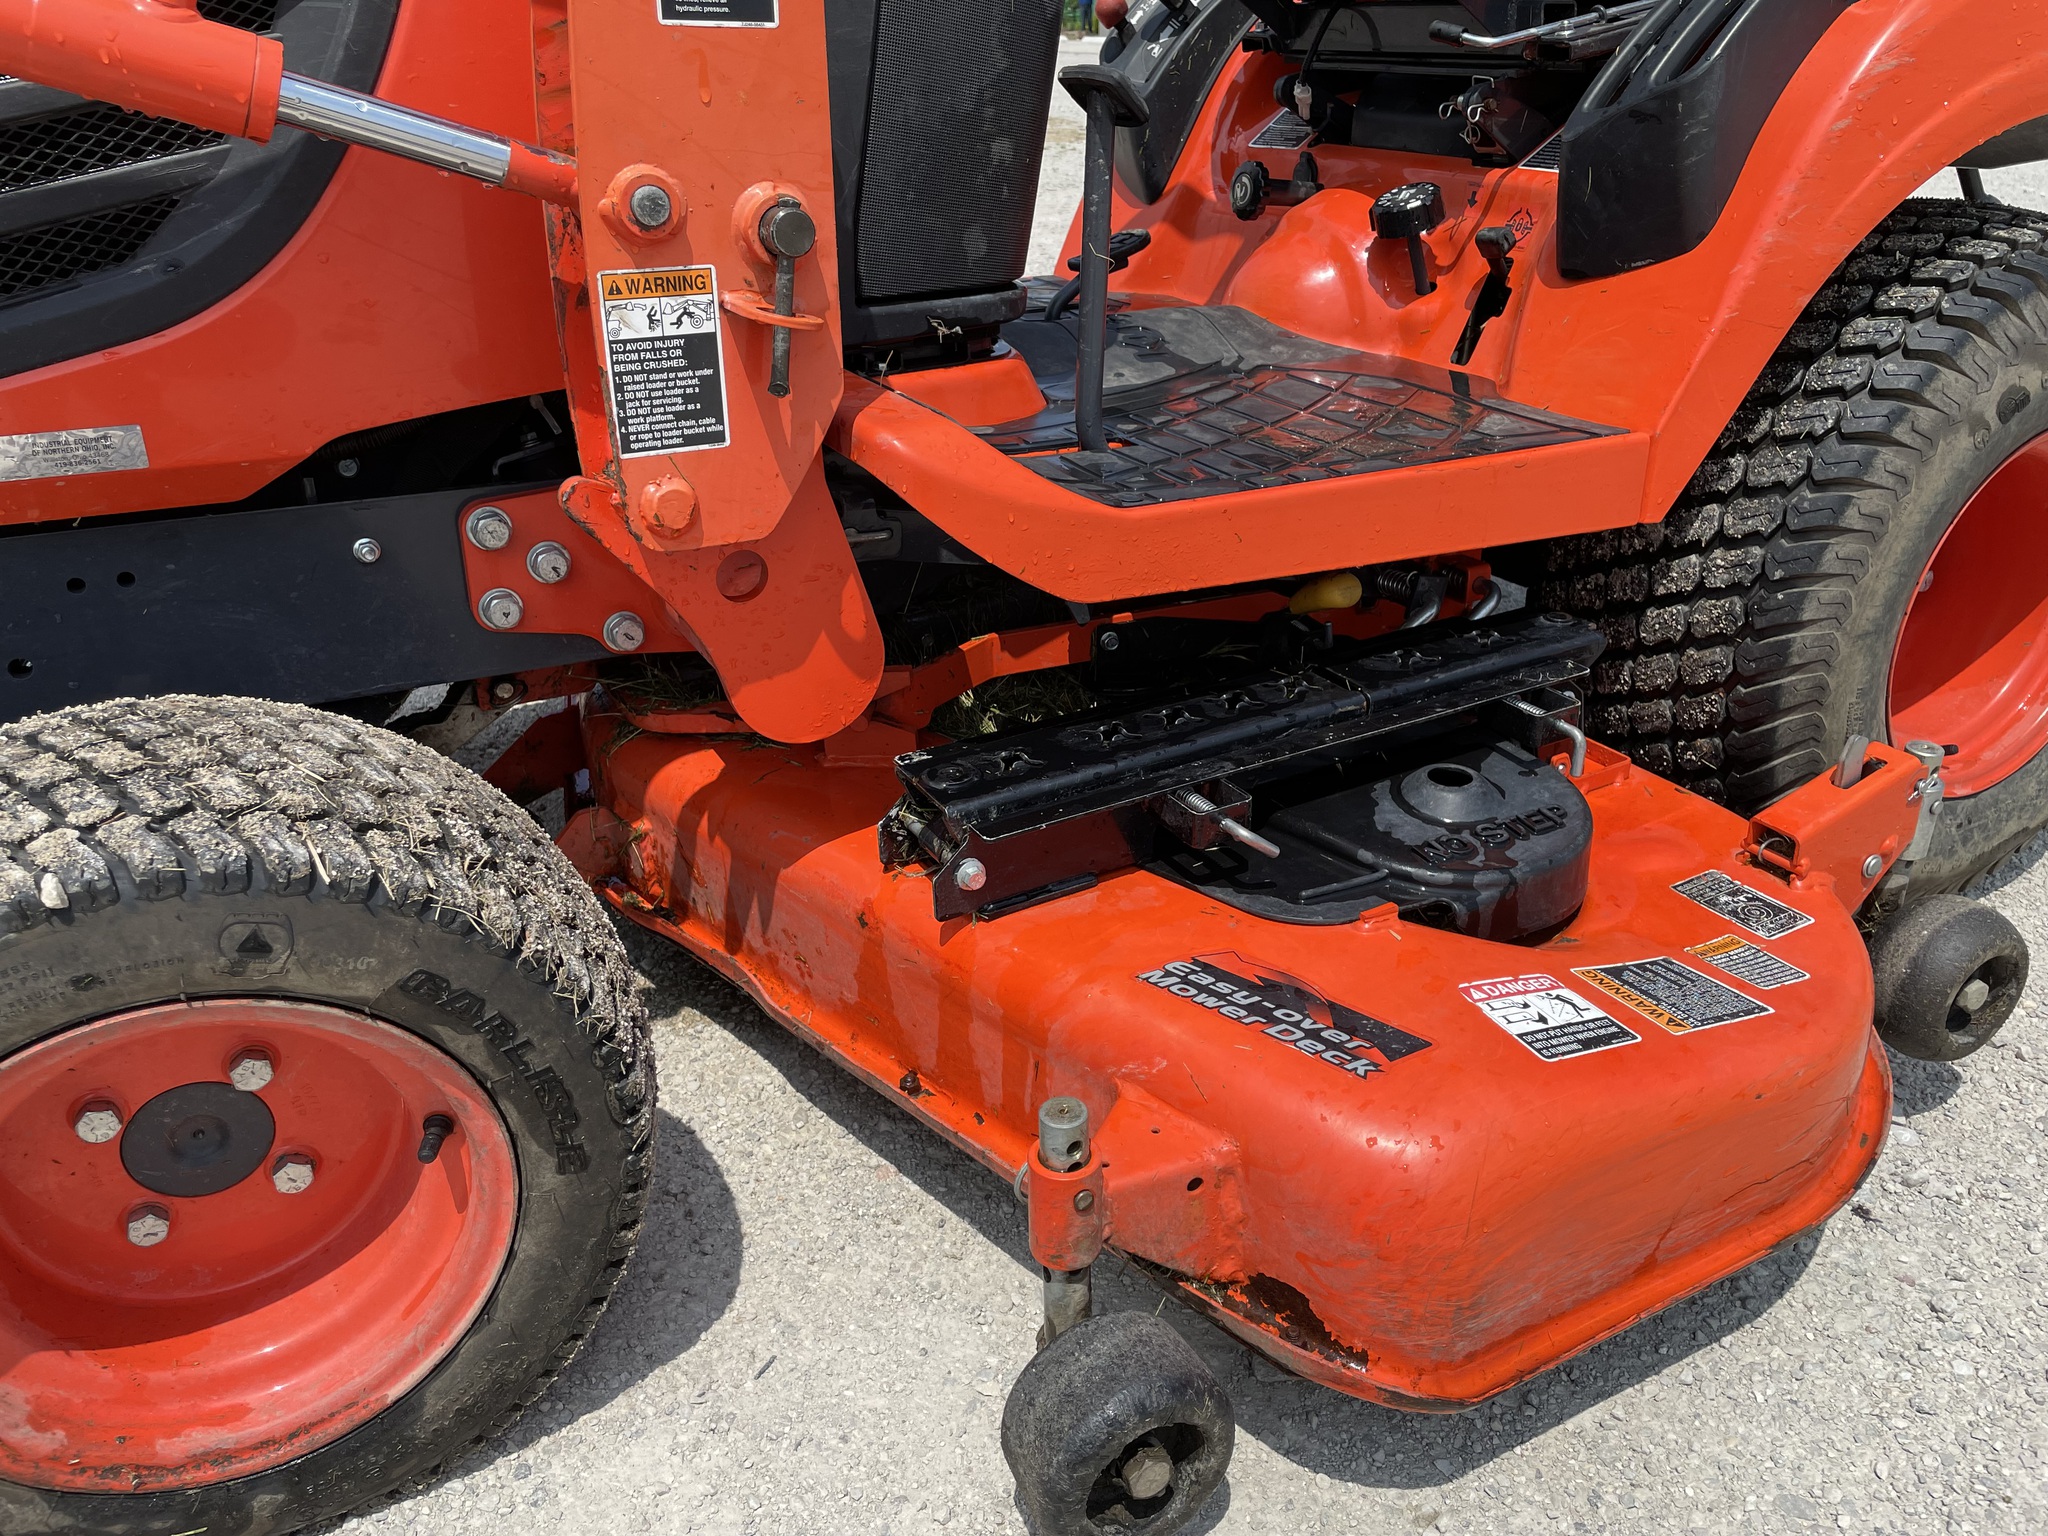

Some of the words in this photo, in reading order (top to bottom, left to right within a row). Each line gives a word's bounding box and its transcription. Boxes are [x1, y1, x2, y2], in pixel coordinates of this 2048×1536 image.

[625, 274, 707, 294] WARNING
[611, 344, 623, 352] TO
[626, 342, 652, 351] AVOID
[654, 339, 685, 349] INJURY
[613, 353, 638, 362] FROM
[640, 350, 667, 360] FALLS
[669, 349, 682, 357] OR
[614, 363, 641, 372] BEING
[643, 359, 688, 370] CRUSHED:
[623, 375, 632, 383] DO
[634, 374, 647, 382] NOT
[649, 372, 667, 380] stand
[695, 368, 713, 376] under
[624, 383, 645, 391] raised
[646, 381, 667, 390] loader
[676, 378, 700, 386] bucket.
[625, 392, 634, 400] DO
[636, 391, 649, 399] NOT
[664, 388, 684, 396] loader
[626, 400, 640, 409] jack
[653, 396, 684, 406] servicing.
[638, 407, 651, 415] NOT
[665, 404, 685, 412] loader
[628, 416, 645, 424] work
[646, 414, 675, 423] platform.
[628, 424, 650, 433] NEVER
[651, 421, 677, 430] connect
[678, 419, 697, 427] chain,
[699, 417, 716, 425] cable
[638, 433, 653, 441] rope
[662, 429, 682, 437] loader
[683, 427, 706, 435] bucket
[706, 424, 723, 432] while
[32, 440, 71, 449] INDUSTRIAL
[74, 436, 112, 445] EQUIPMENT
[630, 441, 661, 450] operating
[662, 437, 684, 445] loader.
[43, 446, 79, 455] NORTHERN
[1411, 834, 1476, 866] NO
[1475, 804, 1568, 847] STEP
[1482, 977, 1558, 997] DANGER
[1581, 970, 1664, 1019] WARNING
[1164, 961, 1376, 1049] Easy-over
[1139, 969, 1267, 1025] Mower
[1262, 1023, 1379, 1078] Deck
[1533, 1032, 1549, 1041] NOT
[1548, 1029, 1563, 1037] PUT
[1562, 1024, 1587, 1034] HANDS
[1595, 1019, 1612, 1027] FEET
[1532, 1041, 1551, 1049] INTO
[1548, 1035, 1577, 1046] MOWER
[1574, 1030, 1597, 1041] WHEN
[1594, 1025, 1621, 1036] ENGINE
[1549, 1042, 1582, 1054] RUNNING
[399, 968, 589, 1176] CARLISLE
